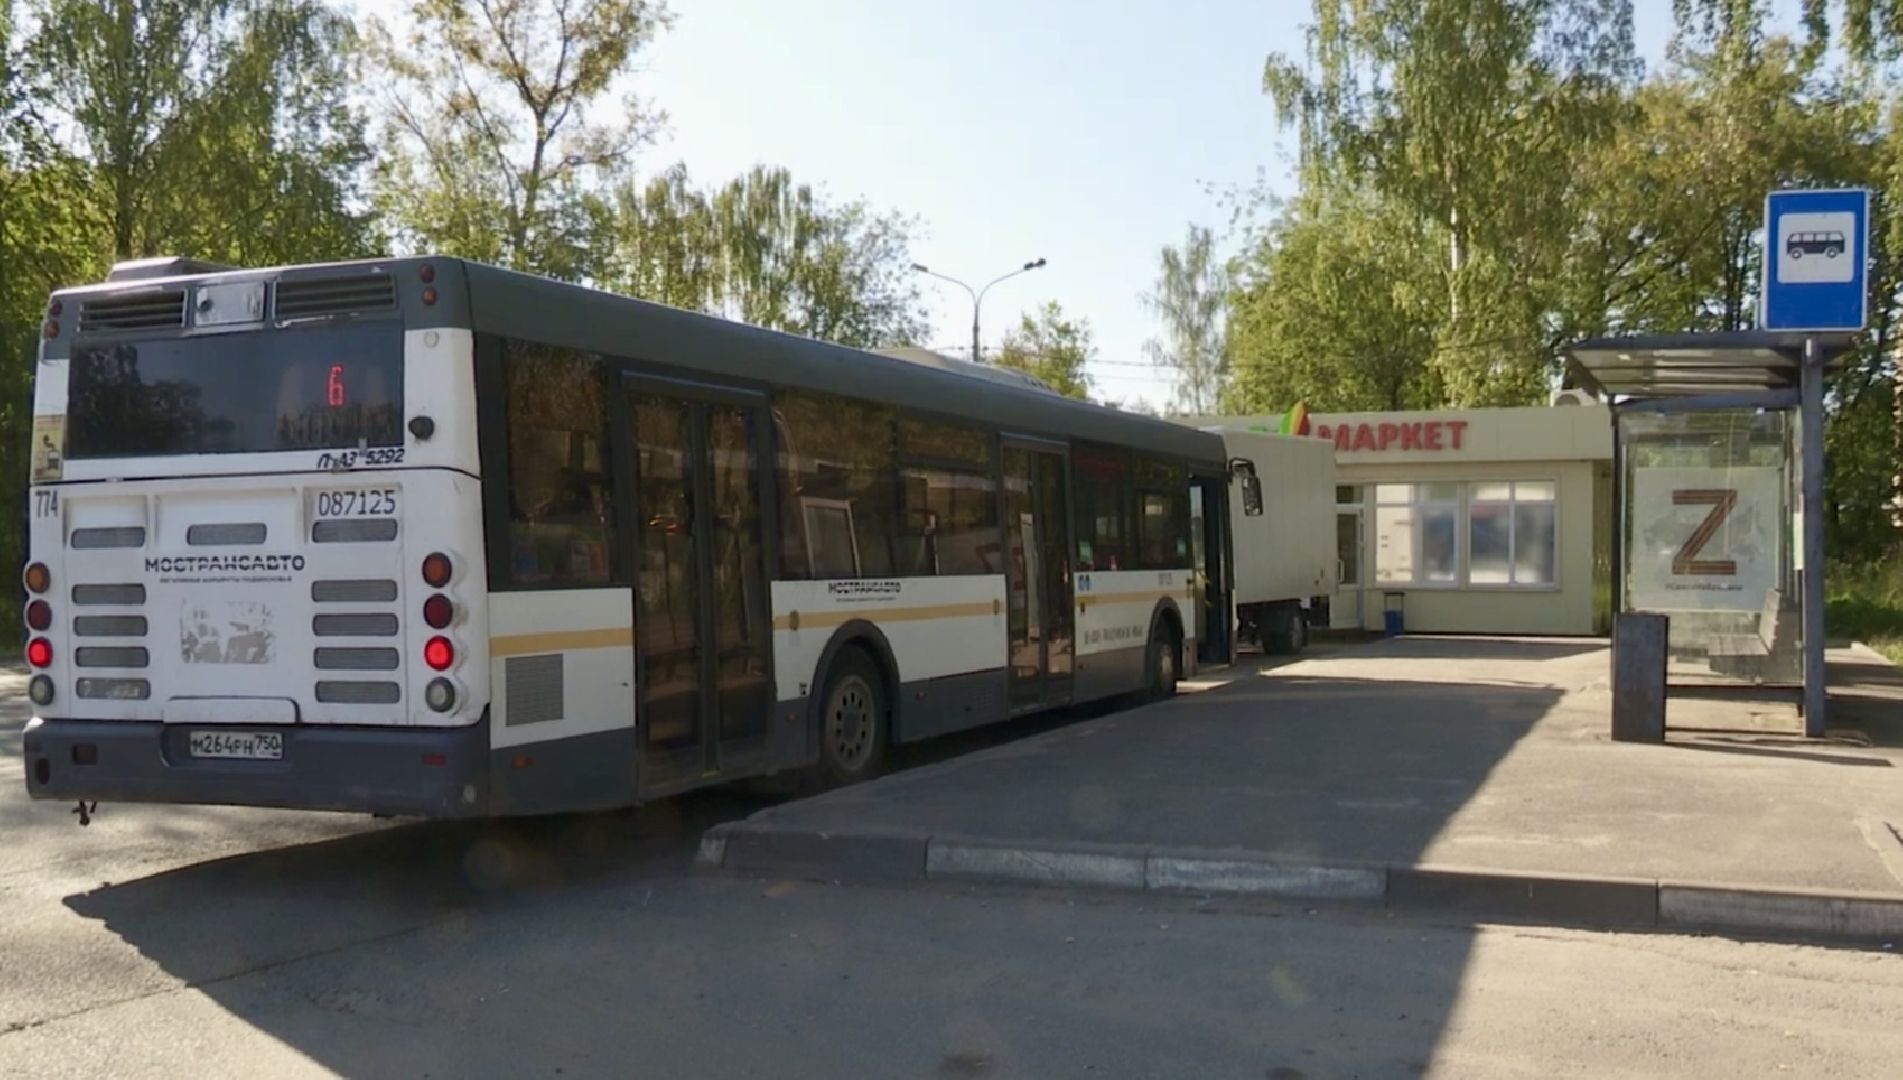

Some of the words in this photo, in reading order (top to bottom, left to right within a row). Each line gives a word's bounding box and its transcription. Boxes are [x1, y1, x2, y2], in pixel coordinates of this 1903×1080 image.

[328, 366, 344, 407] 6
[365, 448, 405, 465] 5292
[35, 490, 58, 518] 774
[318, 489, 397, 517] 087125
[1672, 489, 1738, 576] Z
[145, 555, 305, 573] МОСТРАНСАВТО
